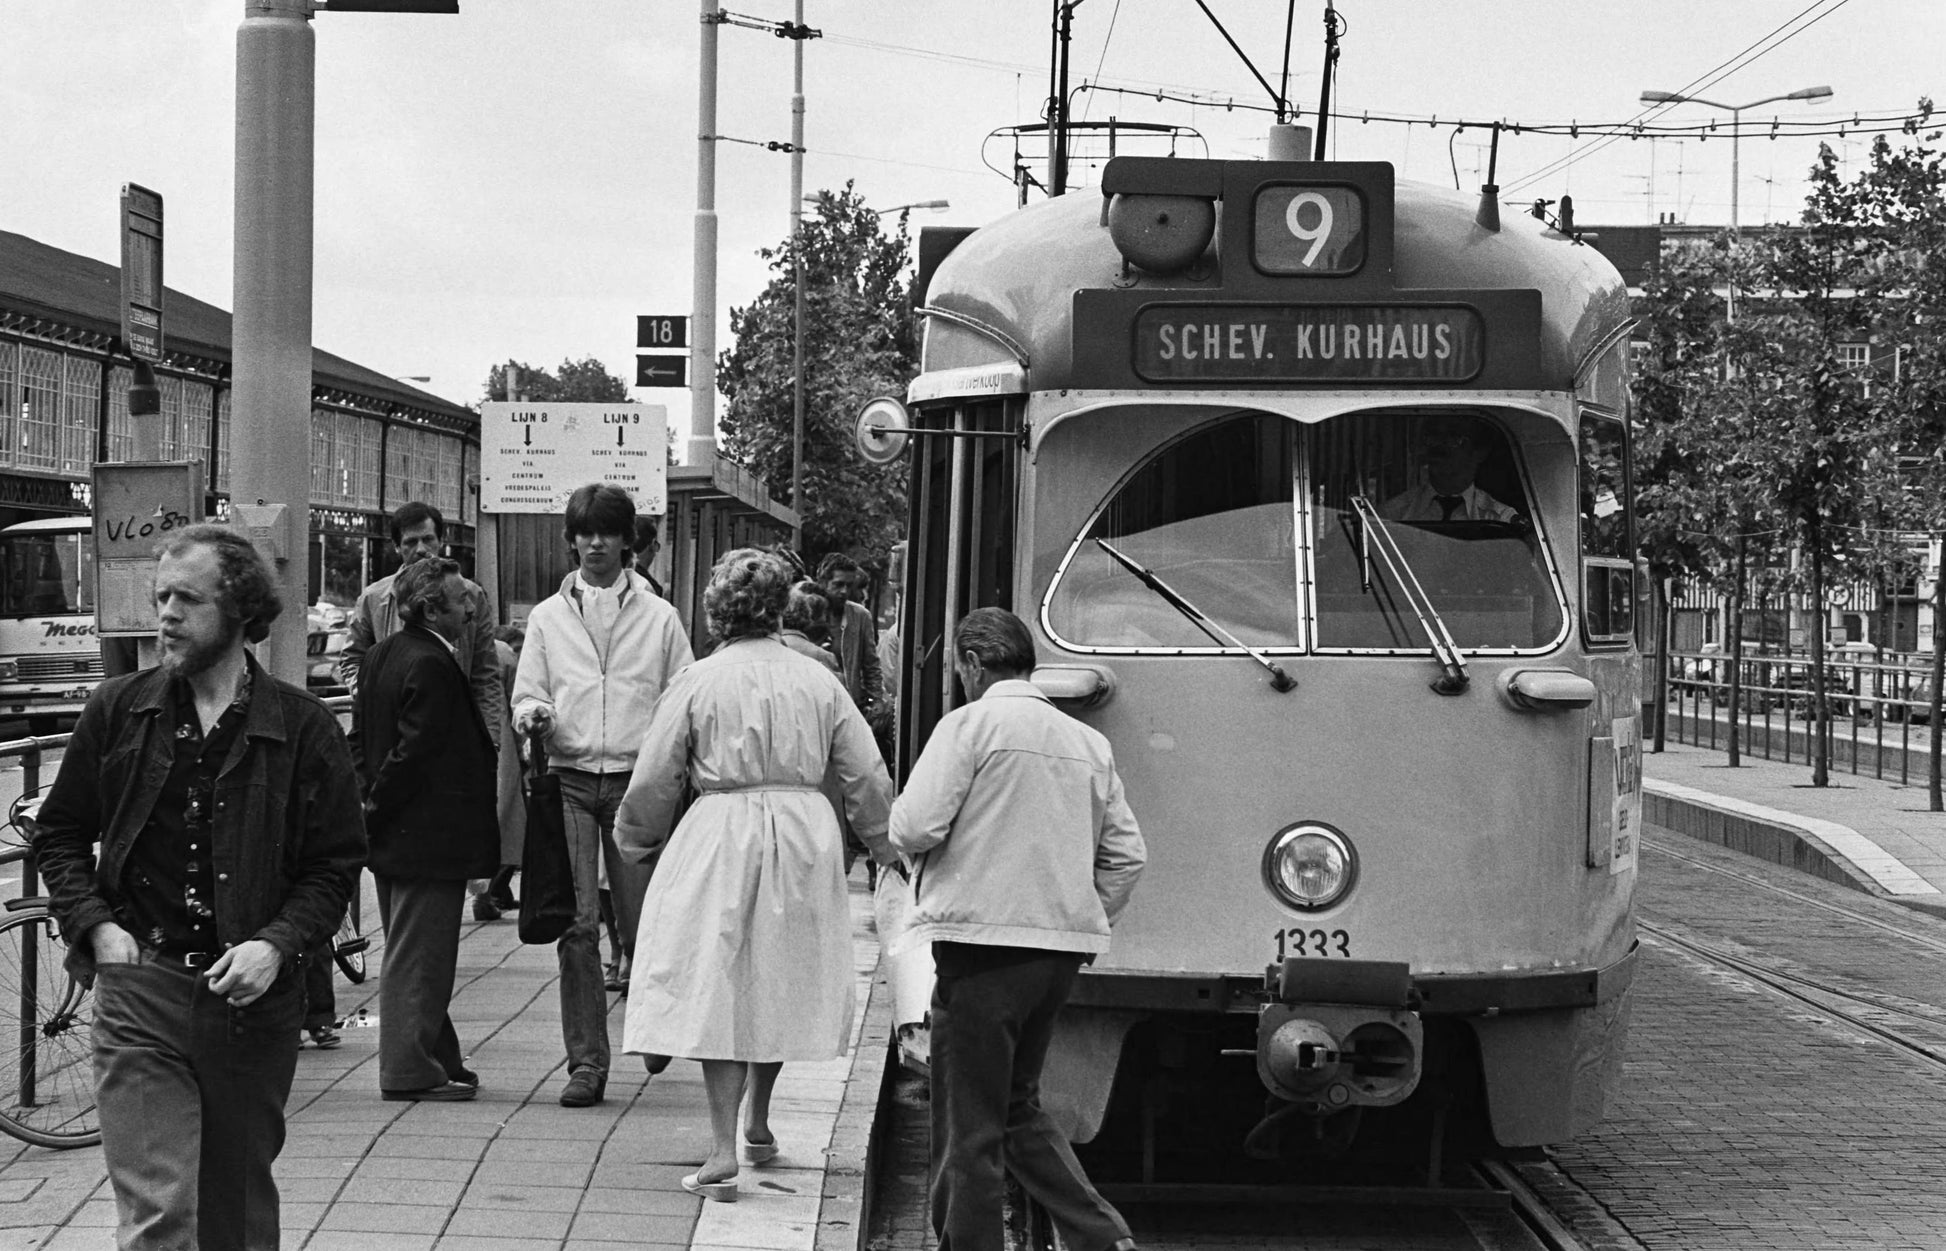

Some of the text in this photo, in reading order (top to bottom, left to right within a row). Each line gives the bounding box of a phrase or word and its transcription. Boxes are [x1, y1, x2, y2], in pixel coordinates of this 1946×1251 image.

[1285, 191, 1334, 268] 9
[650, 319, 673, 343] 18
[1159, 323, 1452, 360] SCHEV. KURHAUS
[511, 412, 548, 423] LIJN 8
[603, 413, 640, 424] LIJN 9
[604, 473, 636, 481] CENTRUM
[1273, 927, 1351, 959] 1333
